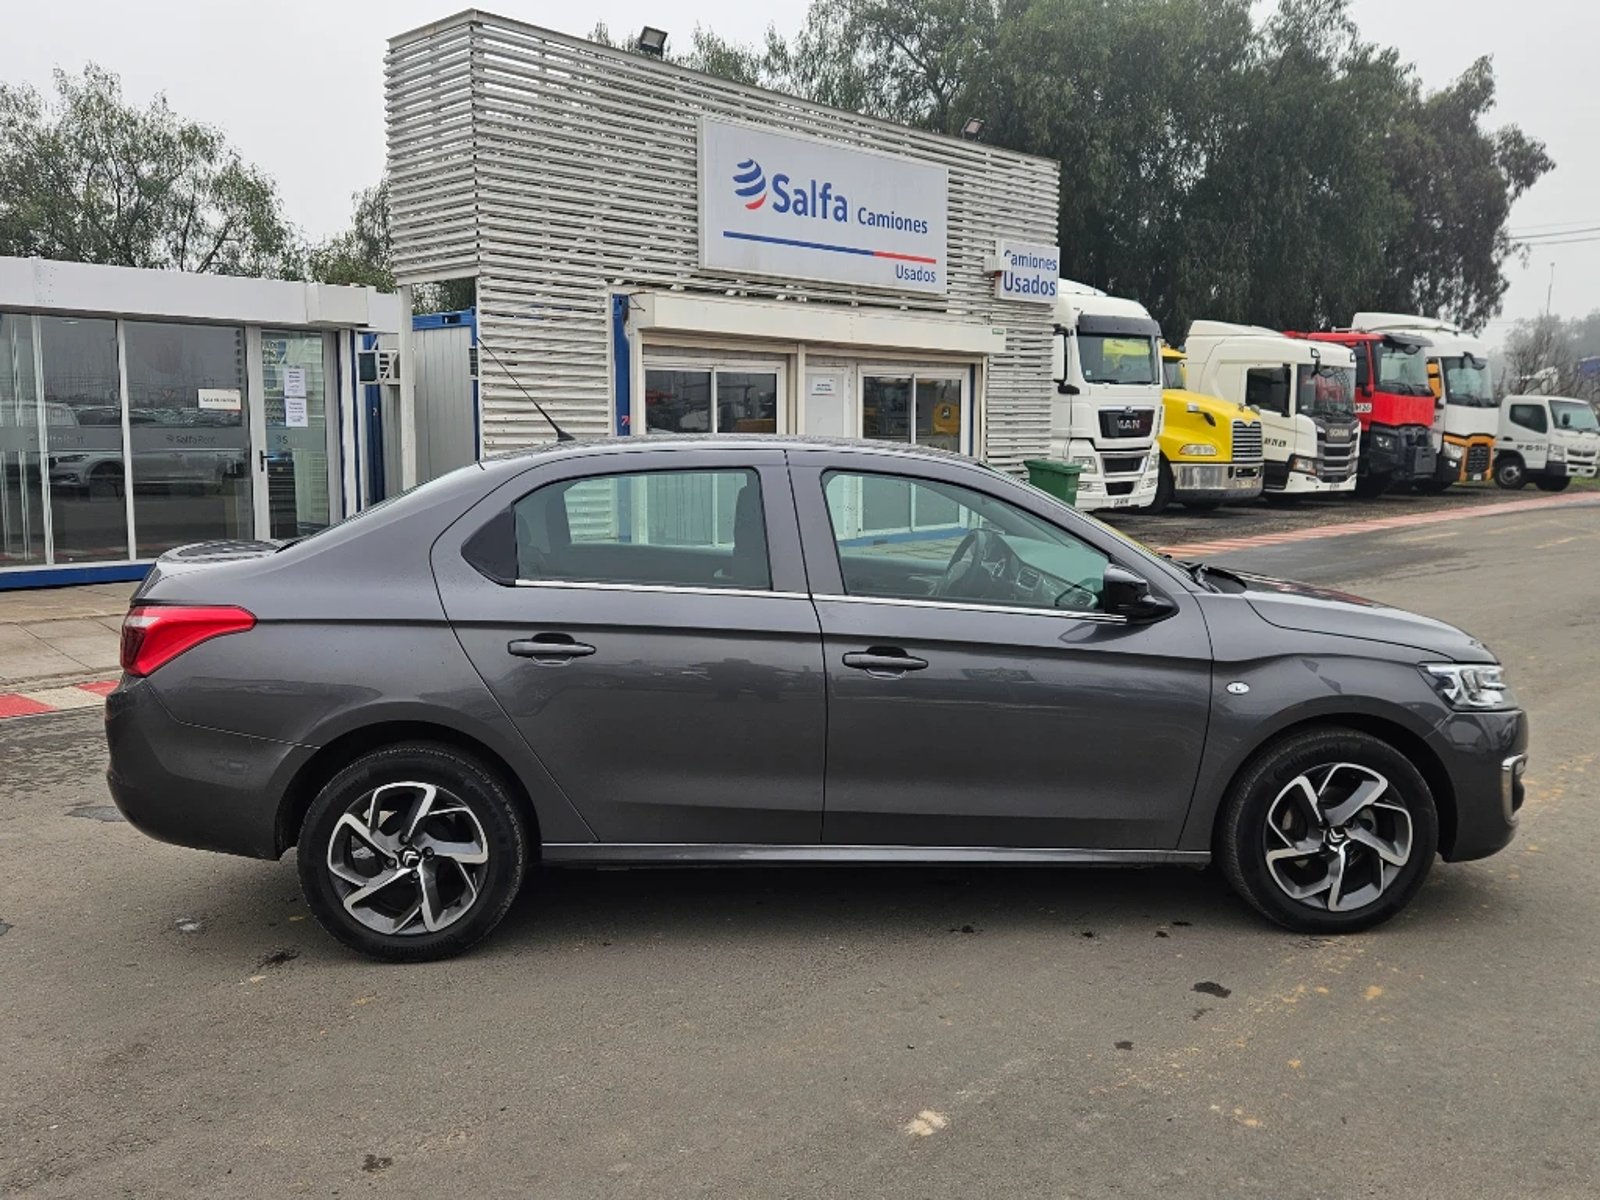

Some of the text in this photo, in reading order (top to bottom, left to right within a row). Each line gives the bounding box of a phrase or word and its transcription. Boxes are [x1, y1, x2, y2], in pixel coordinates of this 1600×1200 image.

[771, 173, 928, 234] Salfa Camiones
[895, 264, 937, 283] Usados
[1004, 271, 1056, 296] Usados
